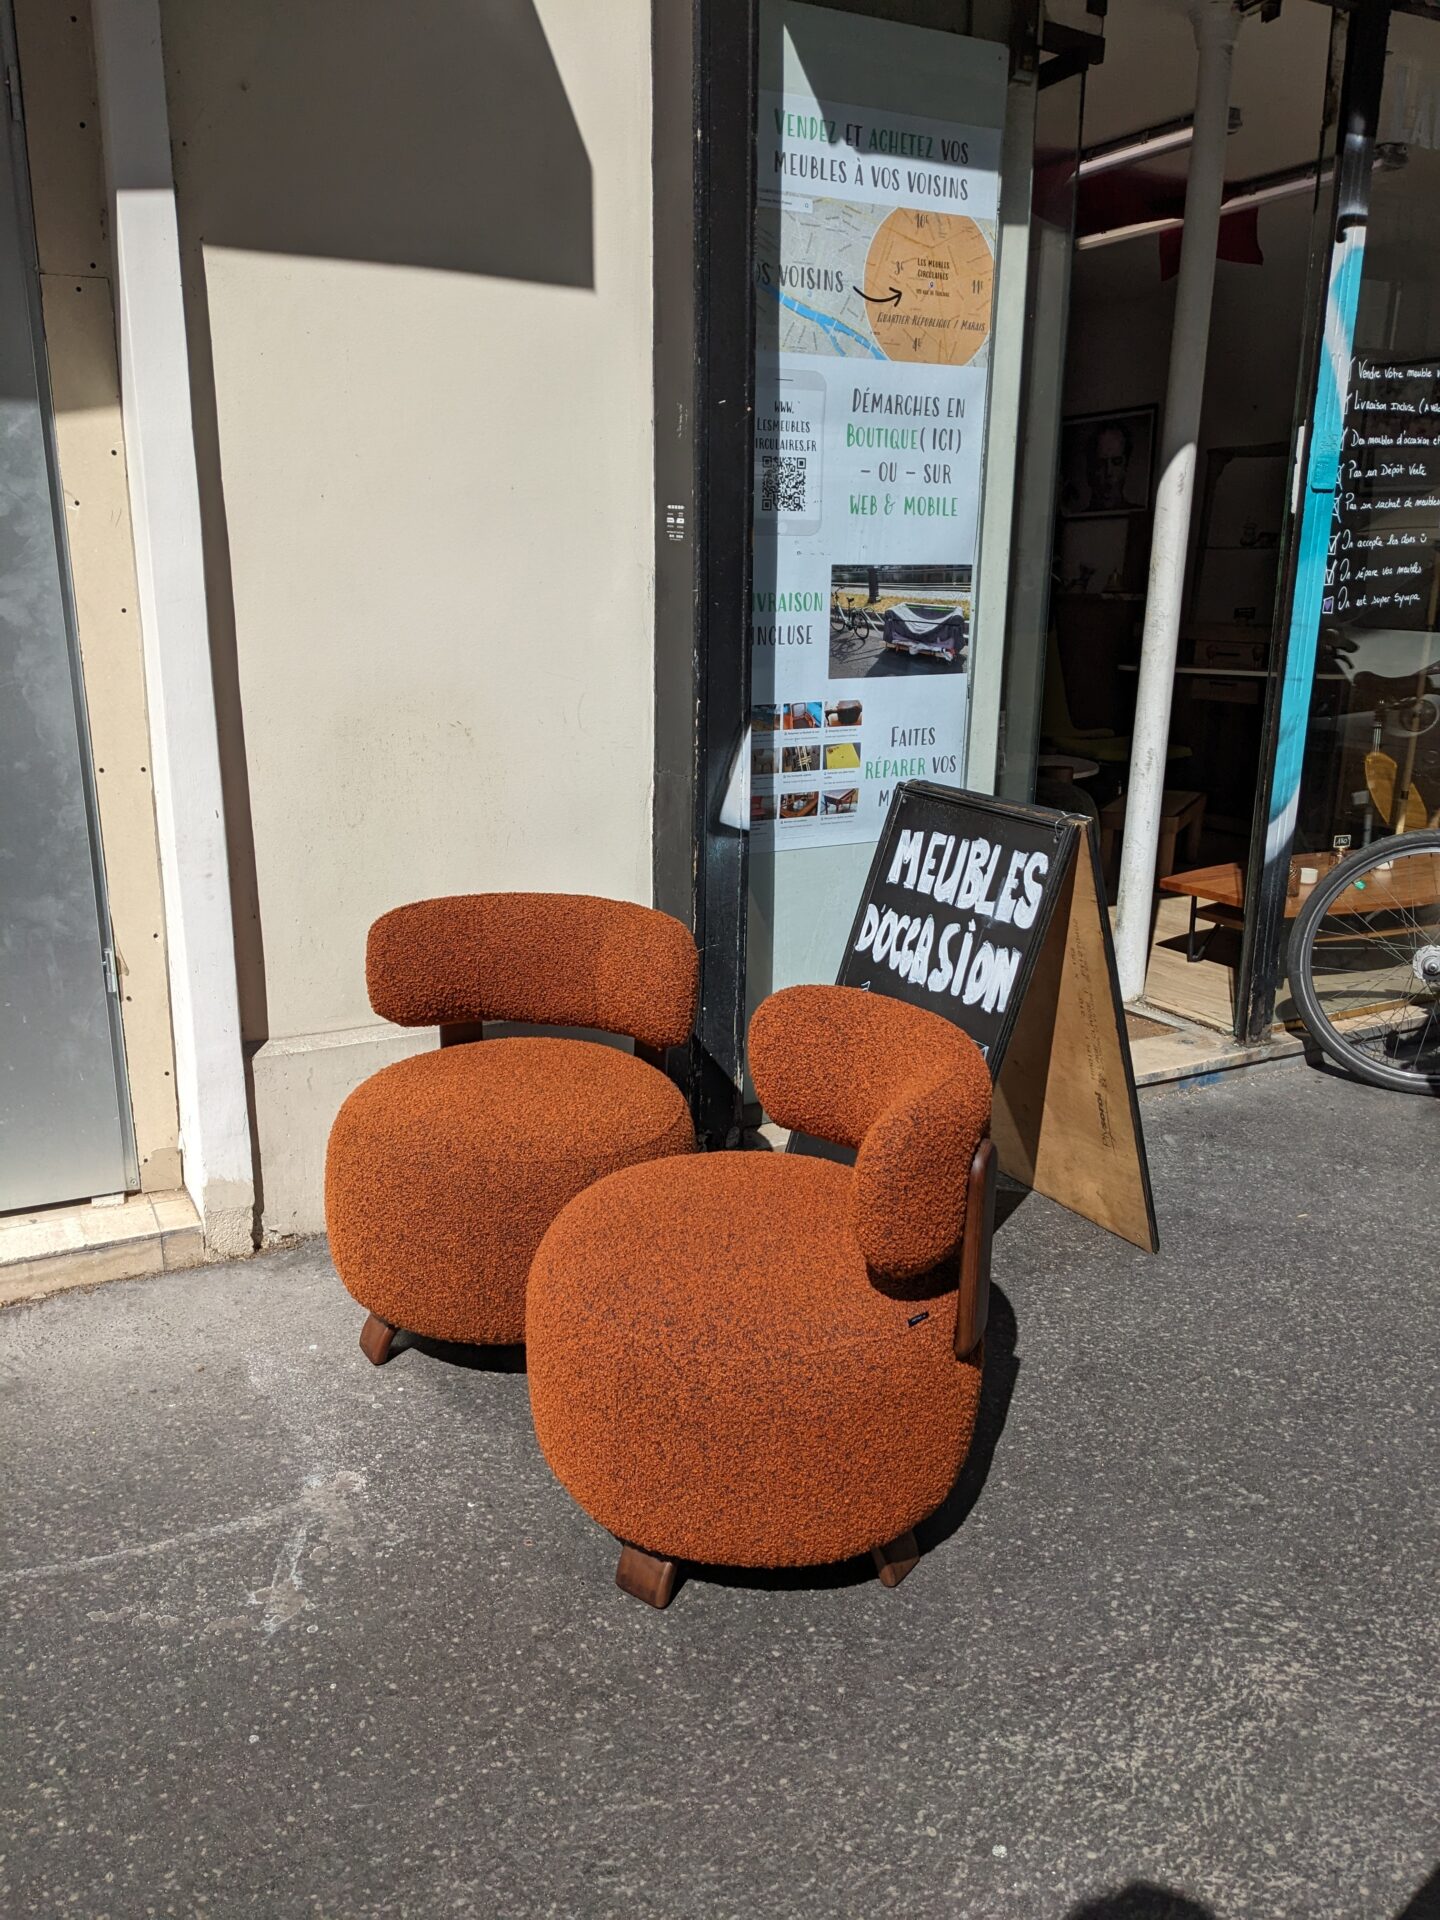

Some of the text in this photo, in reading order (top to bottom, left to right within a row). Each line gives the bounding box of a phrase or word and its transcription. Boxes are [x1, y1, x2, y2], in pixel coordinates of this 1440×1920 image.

[774, 108, 969, 164] VENDEZ ET ACHETEZ VOS
[774, 151, 969, 200] MEUBLES À VOS VOISINS
[777, 263, 844, 293] VOISINS
[960, 320, 986, 332] MARAIS
[1358, 359, 1381, 380] Vendre
[774, 401, 795, 414] WWW.
[852, 387, 966, 418] DÉMARCHES EN
[757, 417, 811, 433] LESMEUBLES
[755, 437, 817, 452] IRCULAIRES.FR
[1396, 430, 1430, 445] d'occasion
[878, 461, 898, 483] OU
[923, 463, 952, 484] SUR
[850, 493, 959, 517] WEB & MOBILE
[752, 592, 824, 613] IVRAISON
[890, 726, 936, 748] FAITES
[865, 755, 926, 780] RÉPARER
[932, 755, 957, 774] VOS
[886, 829, 1049, 930] MEUBLES
